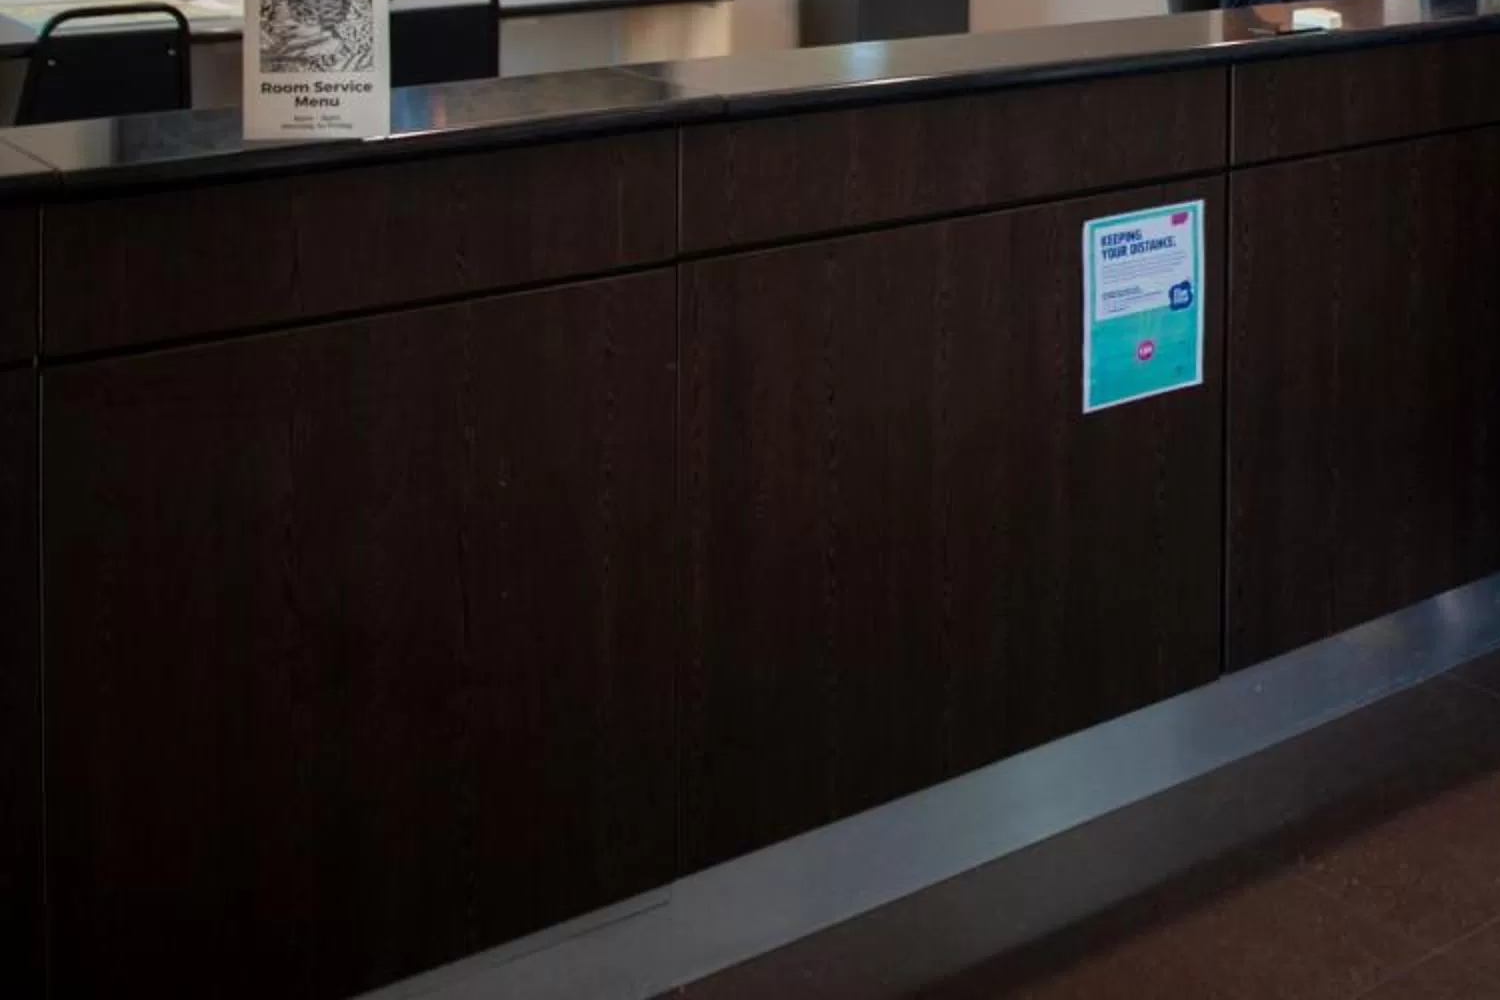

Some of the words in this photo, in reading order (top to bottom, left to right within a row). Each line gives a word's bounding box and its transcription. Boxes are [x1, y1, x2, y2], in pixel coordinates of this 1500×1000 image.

[261, 83, 309, 94] Room
[314, 81, 373, 93] Service
[295, 96, 340, 108] Menu
[1101, 229, 1142, 246] KEEPING
[1102, 246, 1128, 260] YOUR
